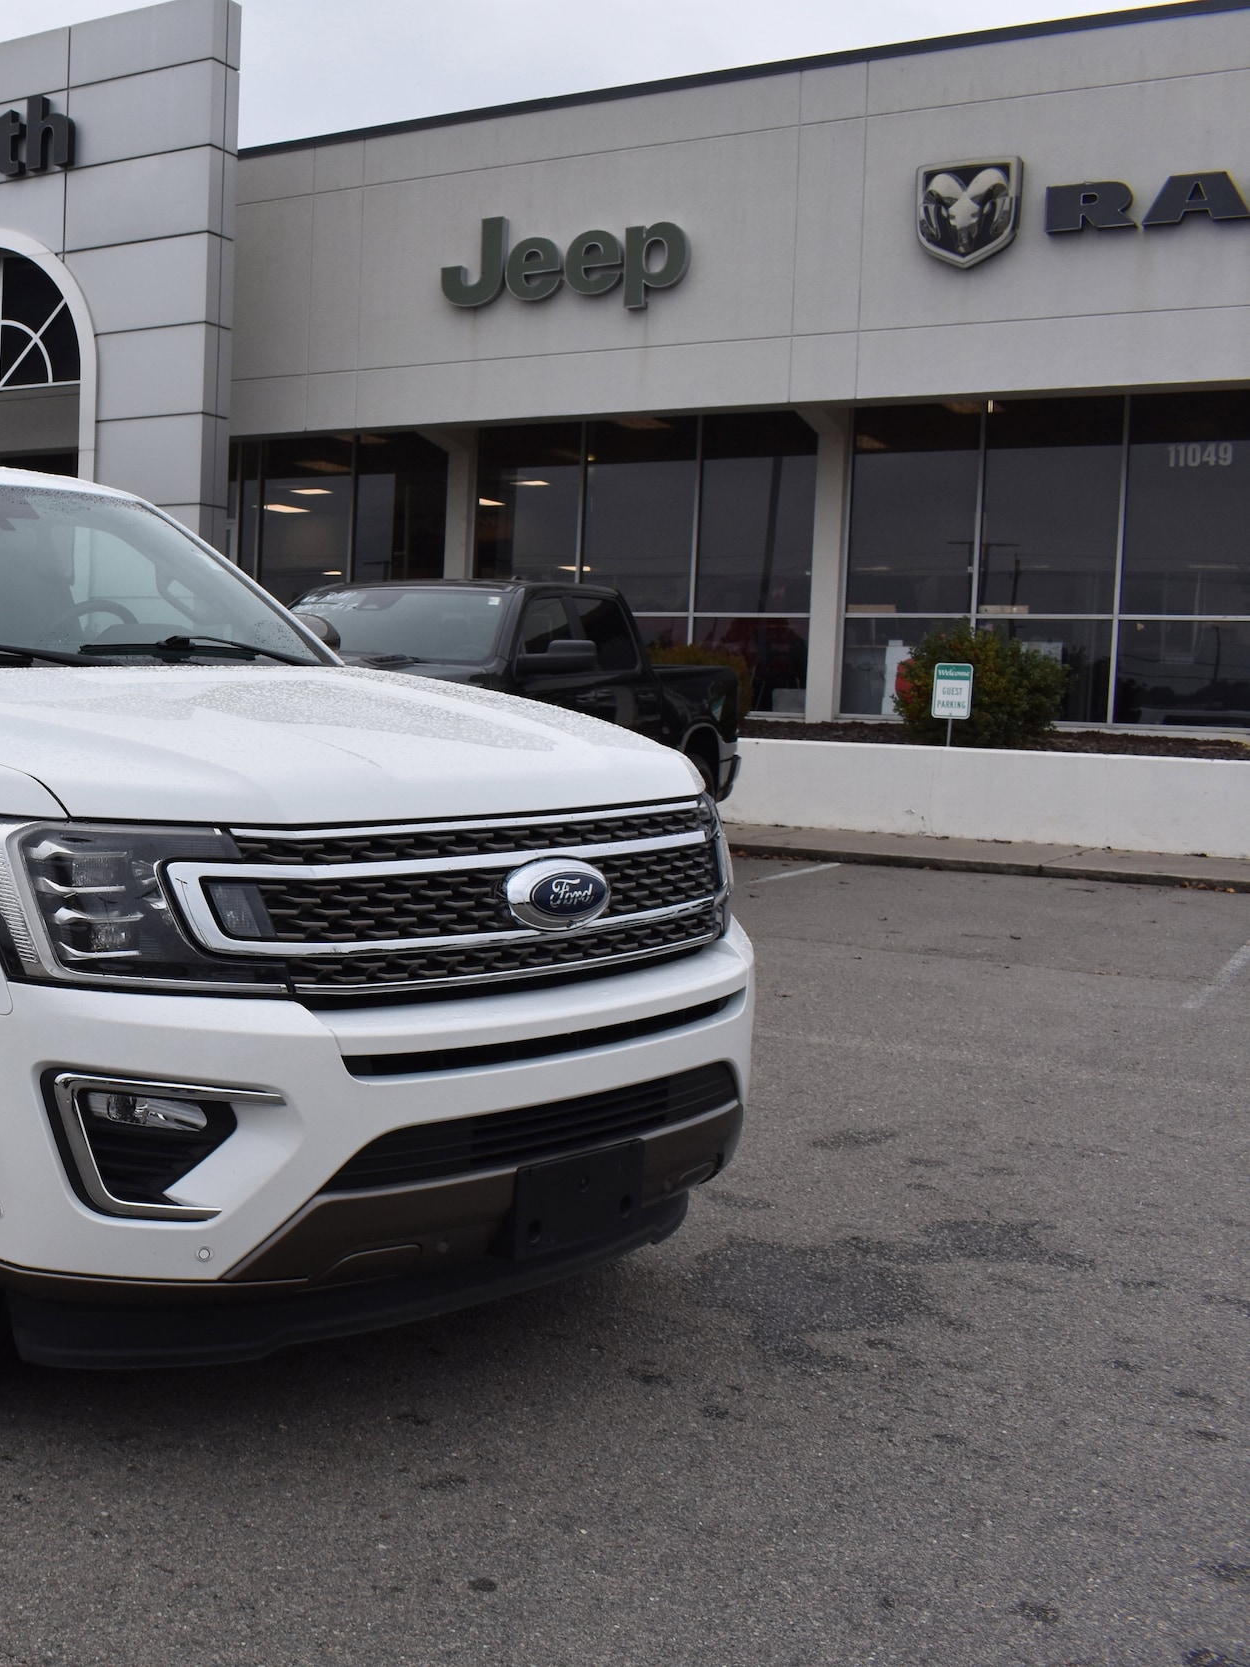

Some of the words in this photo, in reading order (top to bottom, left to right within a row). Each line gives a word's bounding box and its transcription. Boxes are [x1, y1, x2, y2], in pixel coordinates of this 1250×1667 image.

[441, 216, 691, 311] Jeep
[1167, 441, 1233, 468] 11049
[937, 669, 970, 677] Welcome
[942, 687, 963, 696] GUEST
[937, 700, 967, 709] PARKING
[549, 878, 595, 909] Ford
